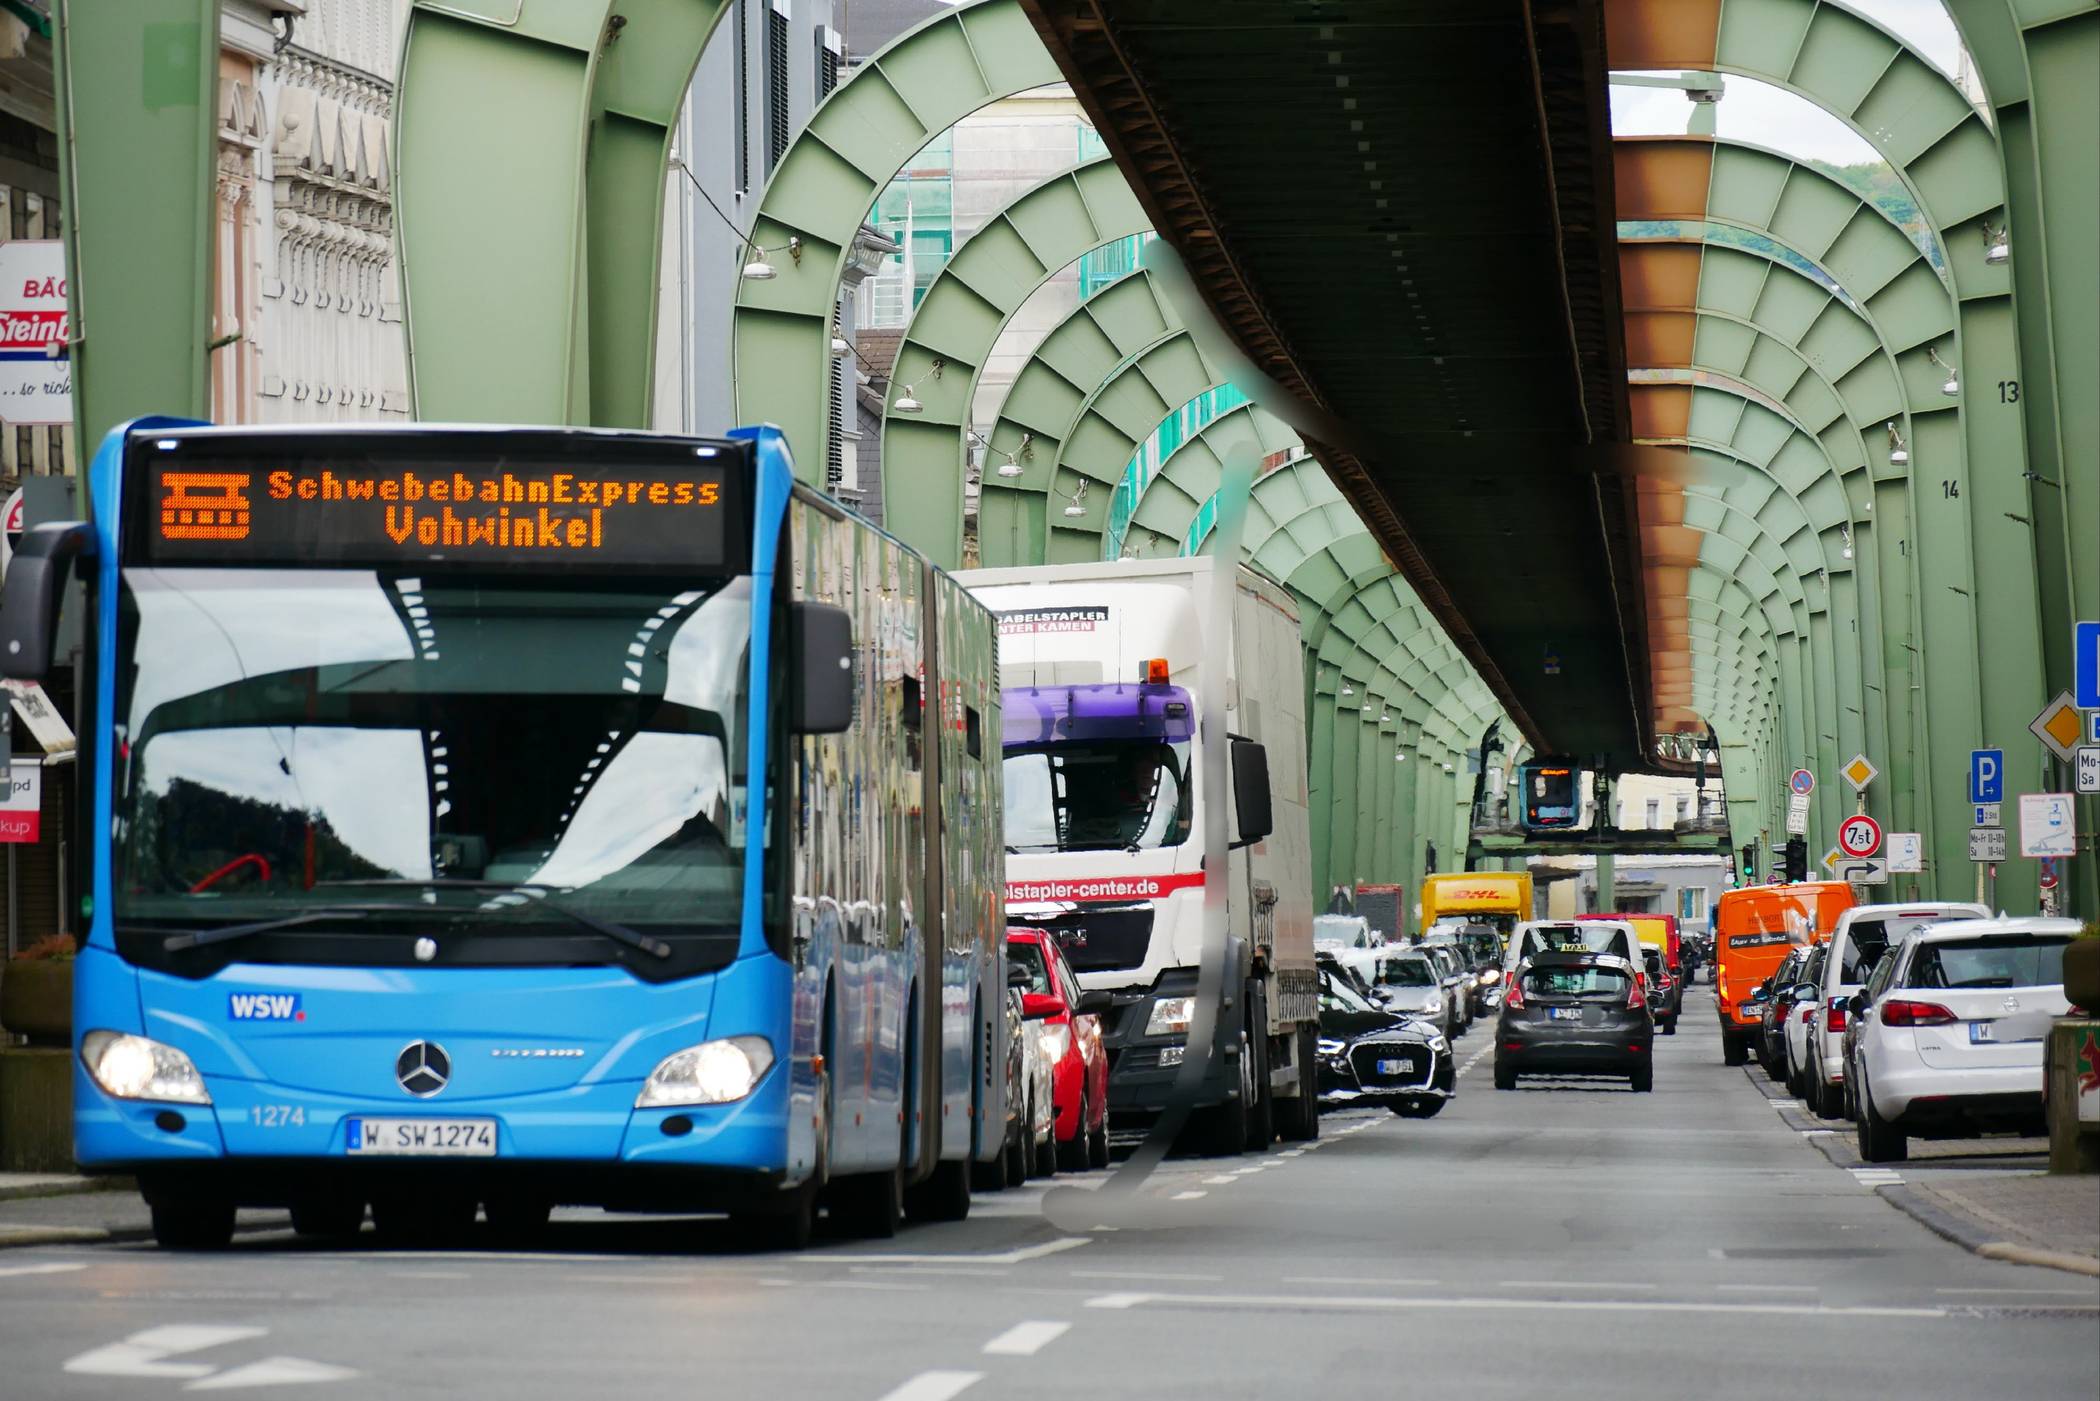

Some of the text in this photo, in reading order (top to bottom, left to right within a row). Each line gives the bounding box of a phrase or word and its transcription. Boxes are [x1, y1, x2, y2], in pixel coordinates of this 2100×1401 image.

[43, 375, 71, 395] rich
[1997, 380, 2020, 404] 13
[268, 471, 720, 507] SchwebebahnExpress
[1941, 480, 1960, 499] 14
[384, 505, 602, 548] Vohwinkel
[1037, 621, 1093, 632] KAMEN
[1978, 756, 1997, 797] P
[2080, 772, 2095, 785] Sa
[1847, 827, 1872, 847] 7,5t
[250, 1105, 306, 1127] 1274
